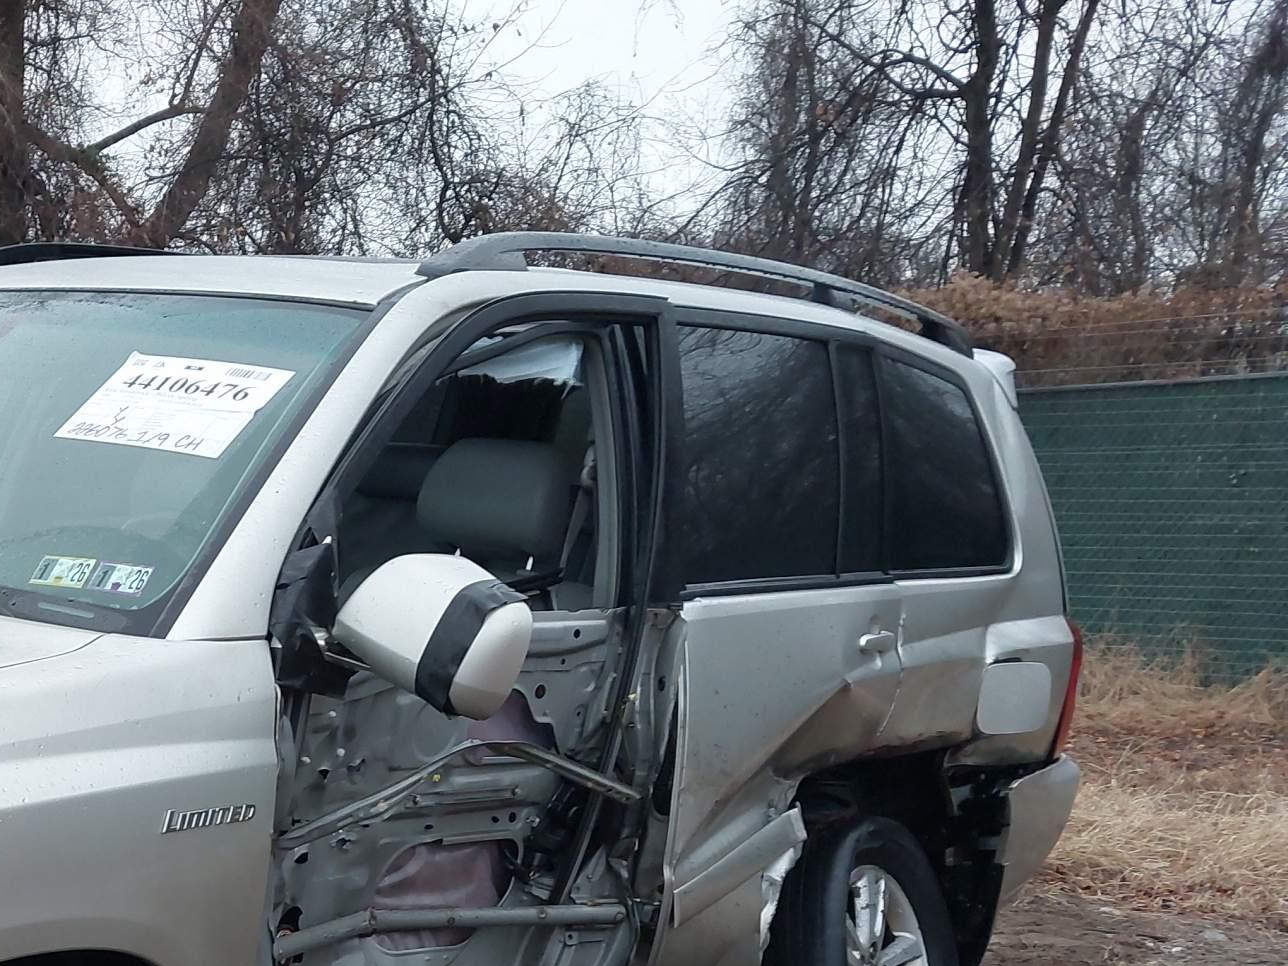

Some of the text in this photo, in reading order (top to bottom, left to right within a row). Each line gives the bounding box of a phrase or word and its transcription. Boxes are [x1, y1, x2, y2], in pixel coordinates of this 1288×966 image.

[123, 373, 257, 402] 44106476
[38, 562, 91, 582] 1 26
[96, 569, 150, 590] 1 26
